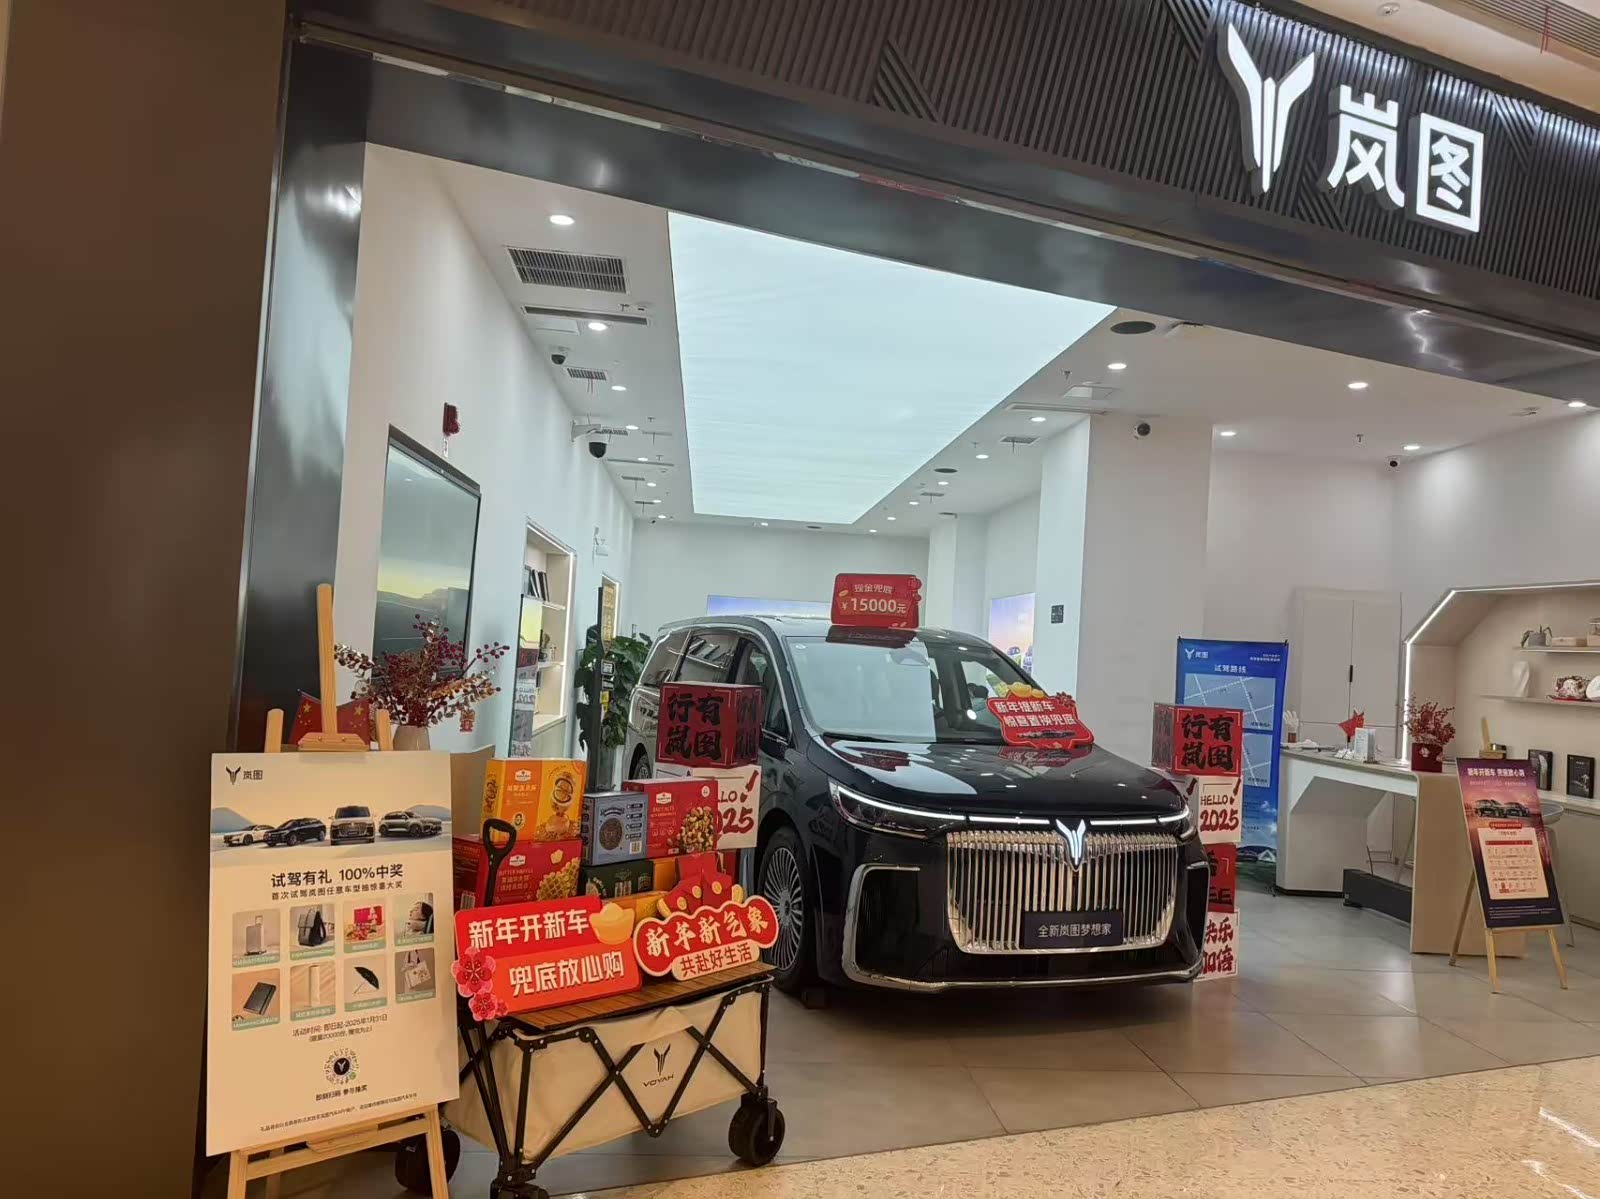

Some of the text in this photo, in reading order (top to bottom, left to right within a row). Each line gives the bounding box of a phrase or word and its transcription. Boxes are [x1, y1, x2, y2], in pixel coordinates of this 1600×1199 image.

[1327, 83, 1484, 233] 岚图
[854, 583, 893, 594] 现金兜底
[1214, 664, 1247, 674] 试驾路线
[994, 700, 1056, 713] 新年提新车
[243, 769, 263, 780] 岚图
[1200, 809, 1239, 832] 2025
[271, 863, 403, 888] 试驾有礼 100%中奖
[271, 880, 403, 900] 首次试驾岚图任意车型抽惊喜大奖
[469, 909, 590, 949] 新年开新车
[646, 906, 769, 957] 新年新气象
[1038, 923, 1112, 938] 全新岚图梦想家
[680, 942, 753, 977] 共赴好生活
[509, 951, 625, 998] 兜底放心购
[643, 1073, 674, 1087] VOYAH
